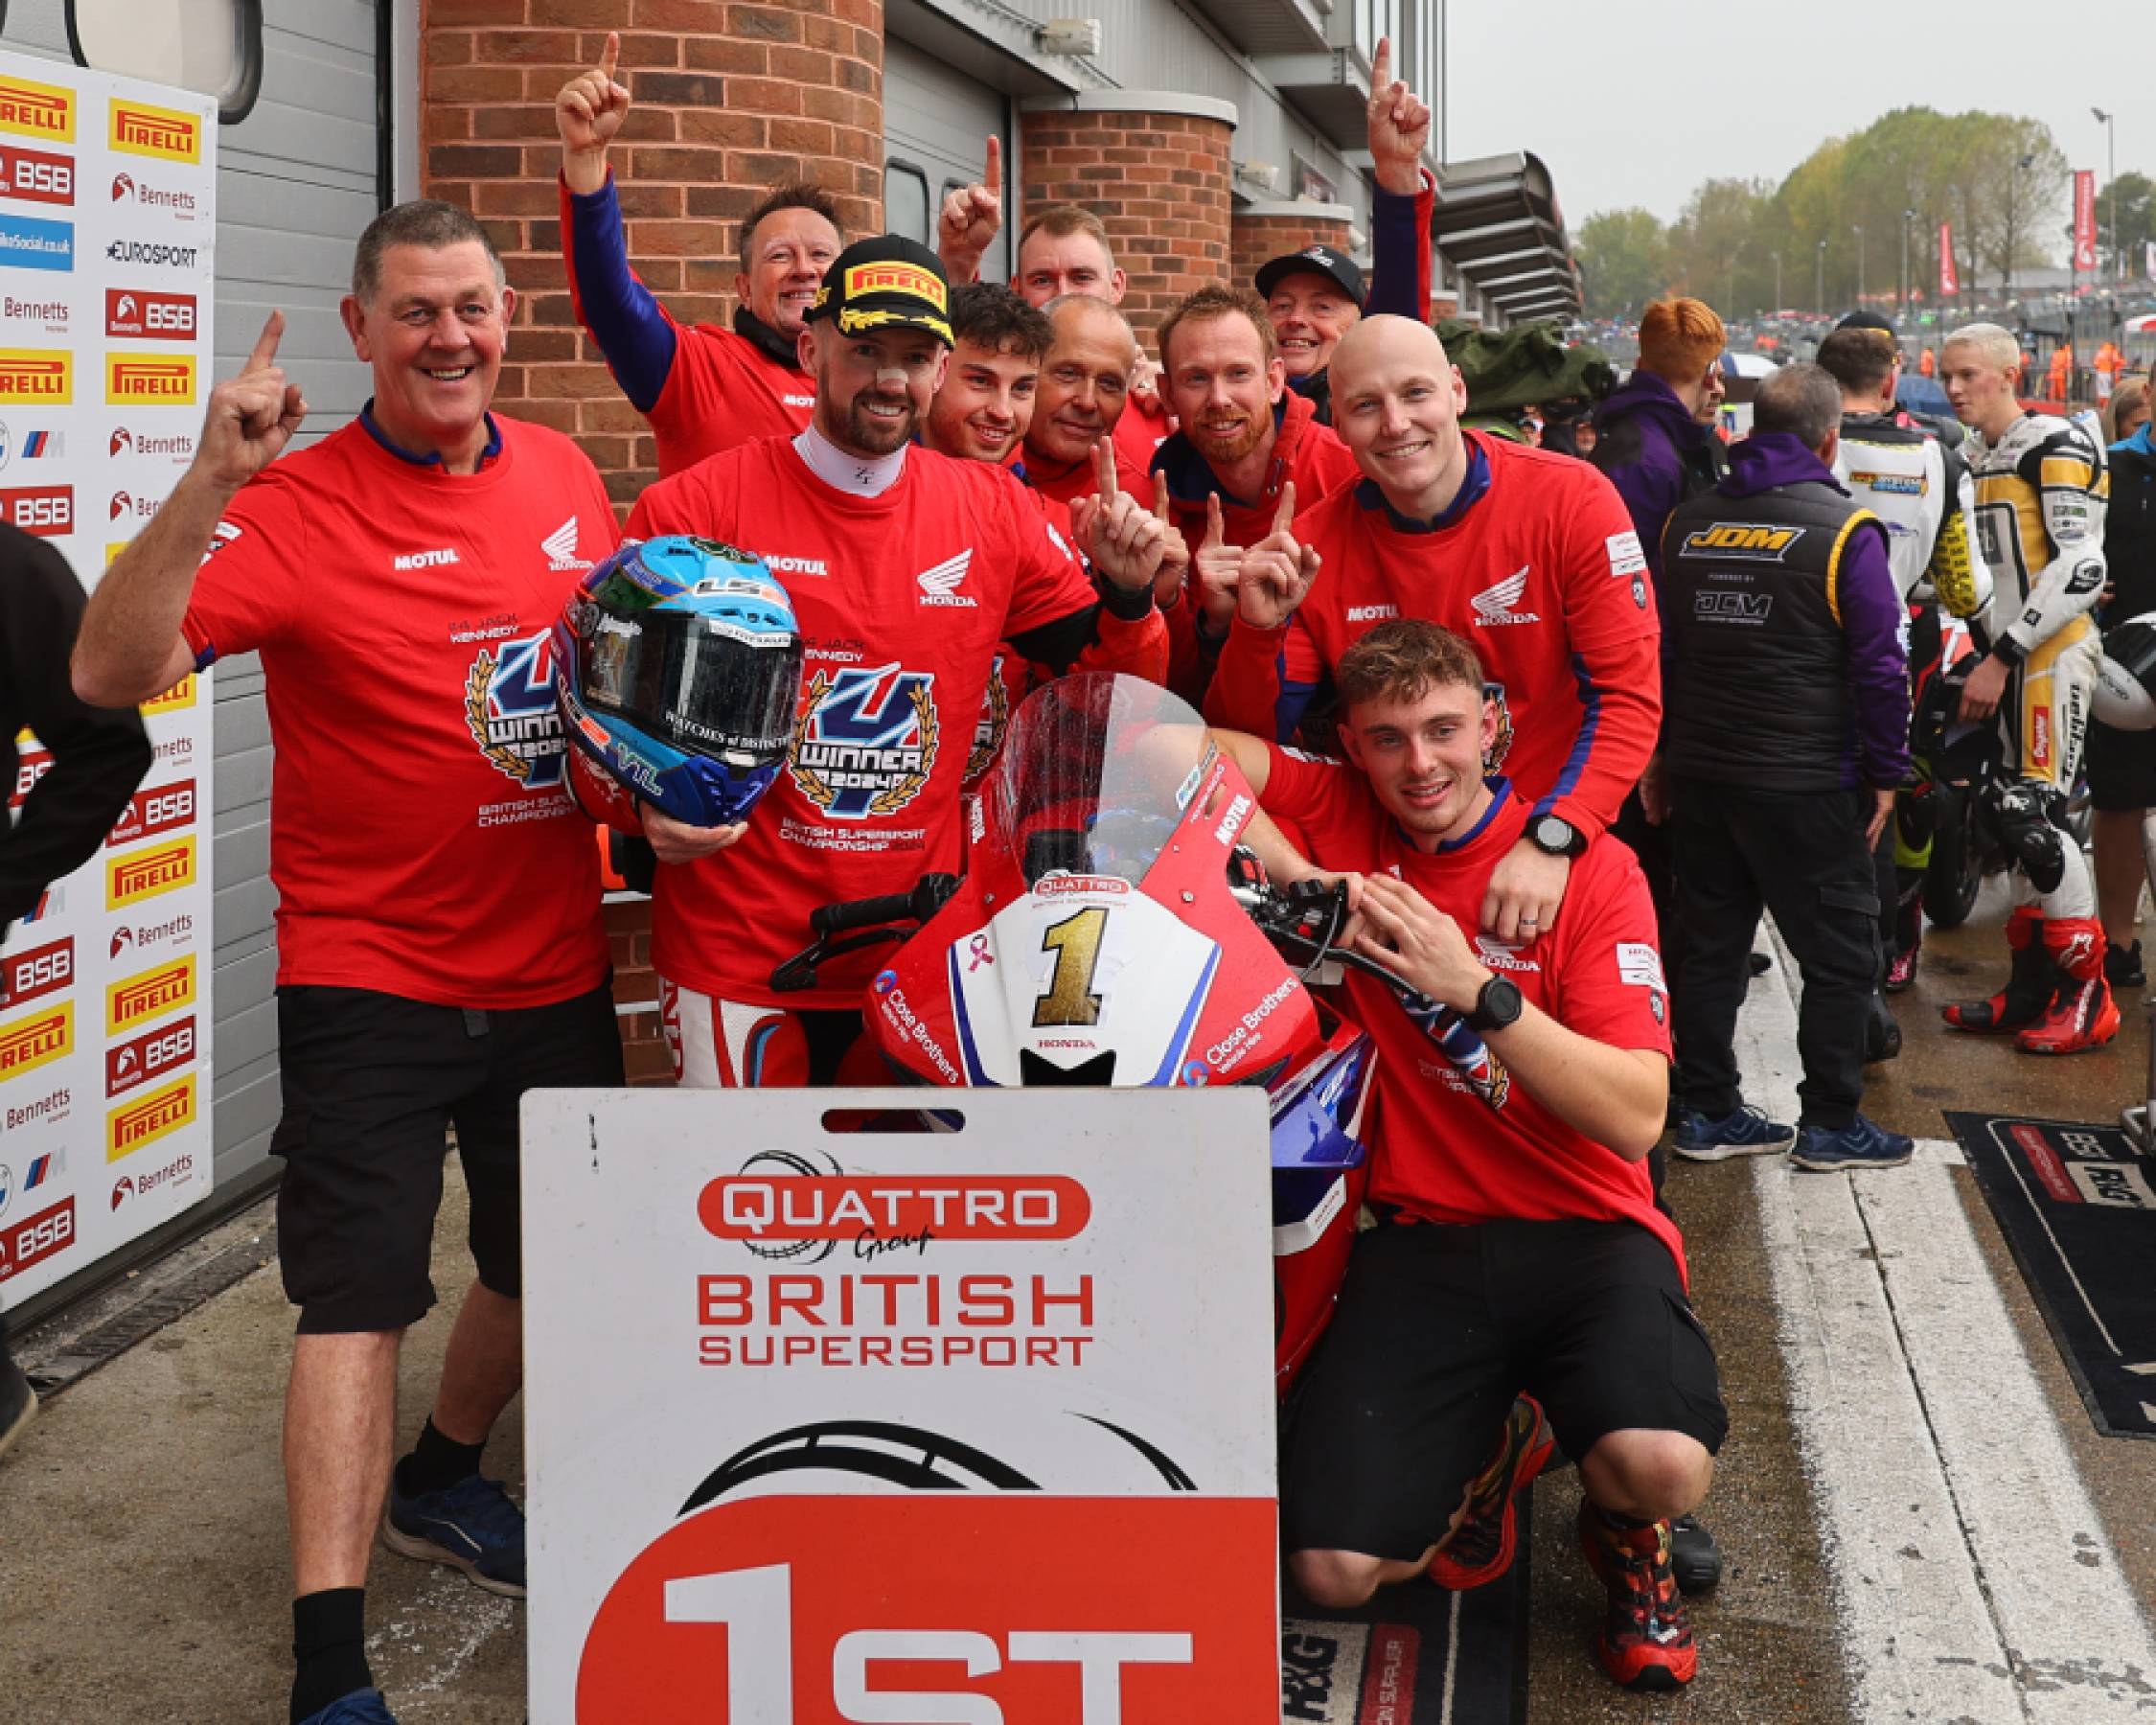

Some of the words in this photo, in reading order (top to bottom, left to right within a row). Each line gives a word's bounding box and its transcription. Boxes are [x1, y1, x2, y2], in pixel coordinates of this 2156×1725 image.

[0, 86, 68, 131] RELLI
[116, 109, 195, 154] PIRELLI
[15, 159, 71, 195] BSB
[139, 183, 195, 211] Bennetts
[112, 240, 197, 268] EUROSPORT
[4, 296, 69, 322] Bennetts
[146, 302, 193, 331] BSB
[0, 359, 65, 394] RELLI
[112, 363, 190, 394] PIRELLI
[783, 394, 815, 407] MOT
[138, 435, 193, 453] Bennetts
[15, 496, 71, 526] BSB
[1690, 526, 1795, 551] JDM
[394, 548, 460, 569] MOTUL
[767, 555, 828, 576] MOTUL
[919, 595, 978, 608] HONDA
[1475, 612, 1541, 627] HONDA
[805, 649, 863, 662] ENNEDY
[489, 715, 563, 744] WINN
[151, 737, 193, 759] nnetts
[800, 745, 922, 770] WINNER
[146, 790, 193, 825] BSB
[115, 846, 190, 899] PIRELLI
[138, 914, 193, 948] Bennetts
[15, 948, 71, 993] BSB
[1032, 906, 1111, 1029] 1
[115, 966, 190, 1024] PIRELLI
[888, 989, 916, 1028] Close
[912, 1022, 958, 1084] Brothers
[1206, 1026, 1247, 1065] Close
[1241, 978, 1298, 1030] Brothers
[0, 1015, 65, 1070] RELLI
[146, 1027, 193, 1070] BSB
[1038, 1039, 1097, 1049] HONDA
[6, 1088, 71, 1130] Bennetts
[115, 1085, 190, 1150] PIRELLI
[138, 1154, 193, 1194] Bennetts
[722, 1183, 1058, 1235] QUATTRO
[17, 1209, 71, 1261] BSB
[853, 1226, 936, 1262] Group
[697, 1274, 1093, 1327] BRITISH
[698, 1336, 1094, 1368] SUPERSPORT
[662, 1561, 1194, 1725] 1ST
